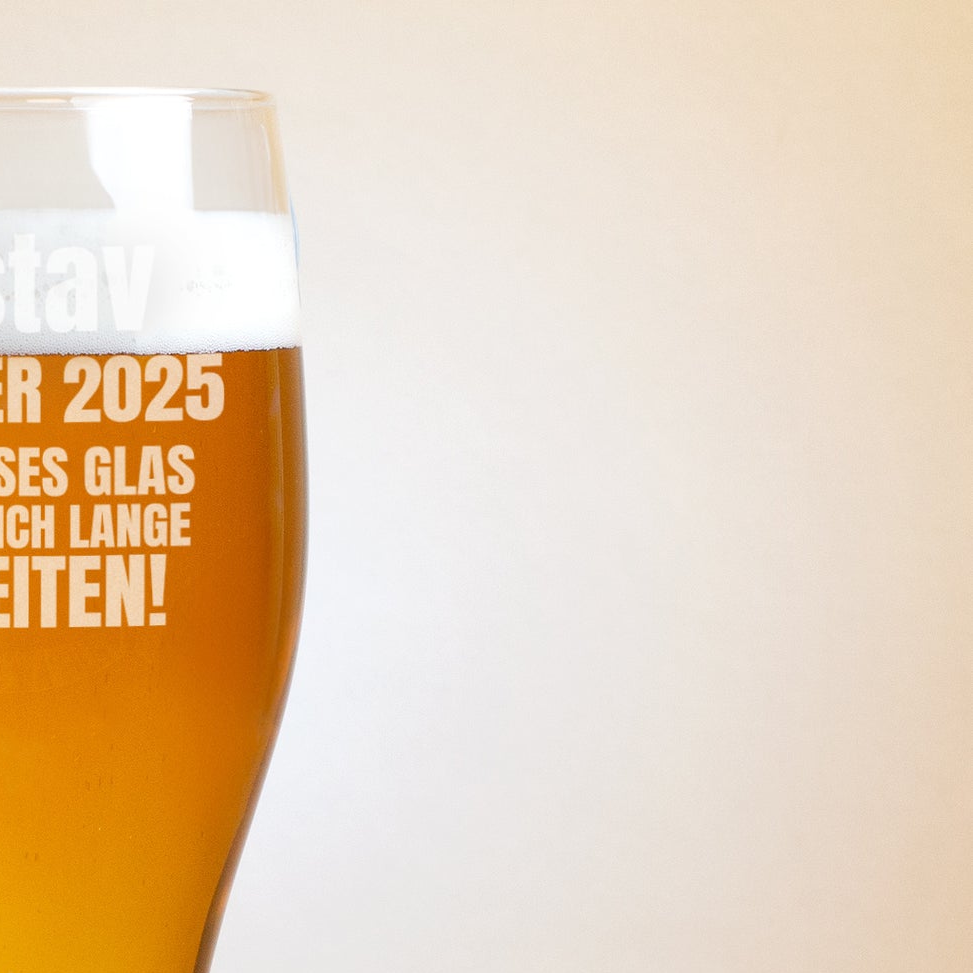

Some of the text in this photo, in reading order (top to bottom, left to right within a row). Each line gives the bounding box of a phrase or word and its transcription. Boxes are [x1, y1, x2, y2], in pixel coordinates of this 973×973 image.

[64, 355, 225, 422] 2025
[85, 445, 196, 495] GLAS
[70, 503, 191, 547] LANGE
